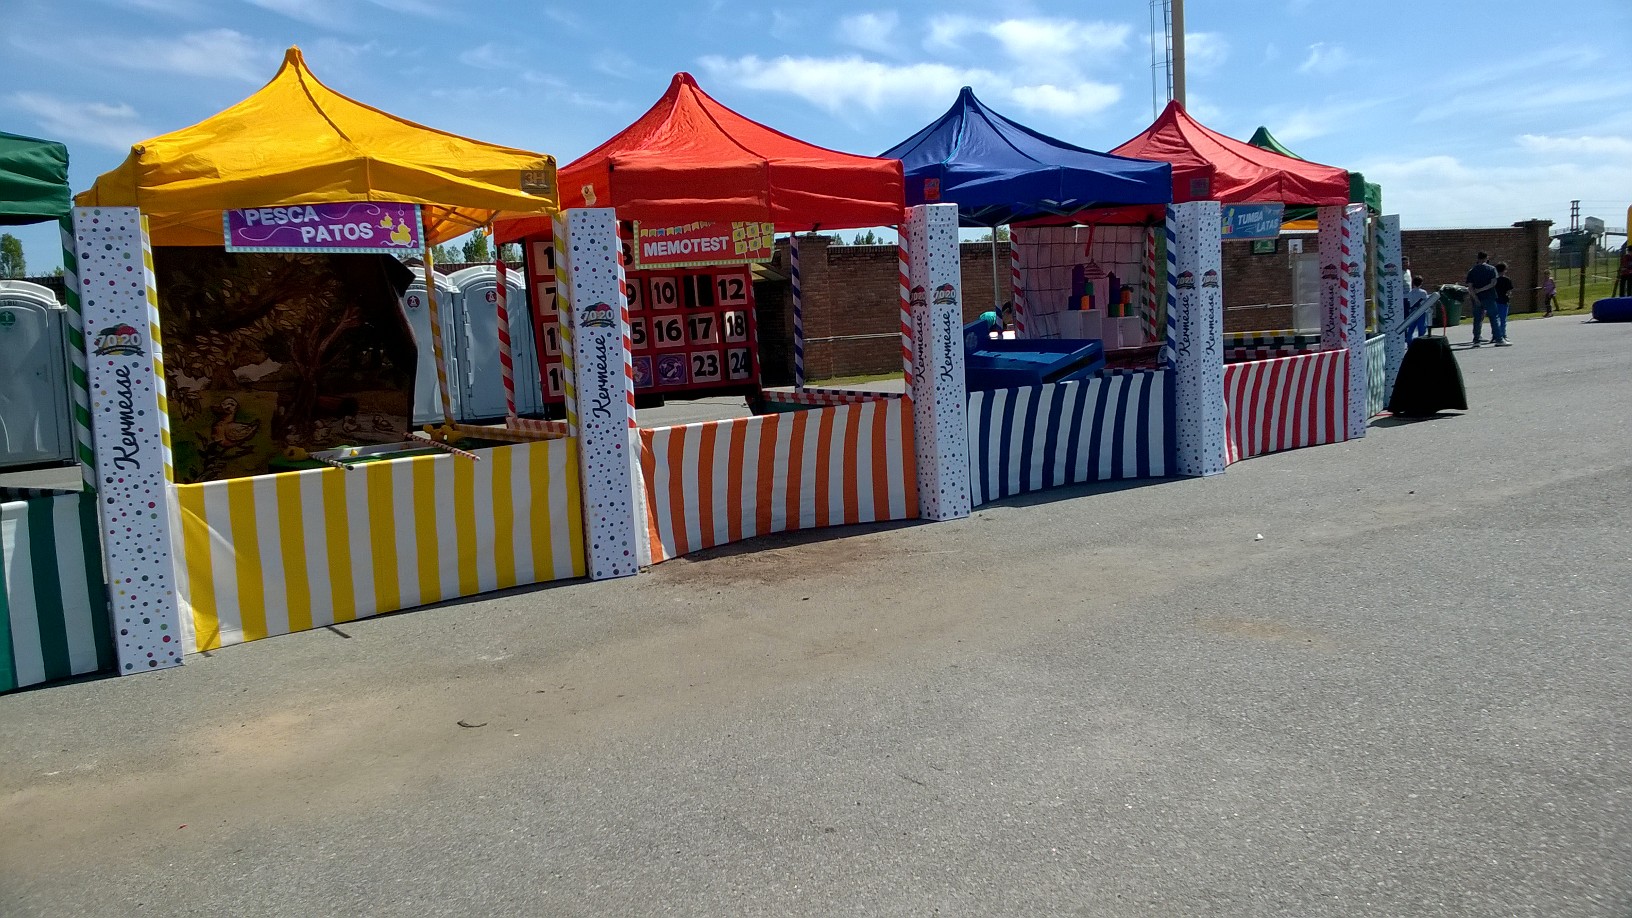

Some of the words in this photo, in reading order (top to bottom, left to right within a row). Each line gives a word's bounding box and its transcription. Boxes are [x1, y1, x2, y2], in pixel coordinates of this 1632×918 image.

[245, 205, 320, 227] PESCA
[300, 222, 374, 244] PATOS
[1237, 210, 1264, 226] TUMBA
[1256, 218, 1280, 233] LATAS
[643, 235, 730, 258] MEMOTEST
[653, 281, 675, 305] 10
[717, 278, 746, 301] 12
[547, 327, 562, 351] 1
[631, 321, 647, 345] 5
[654, 318, 682, 343] 16
[687, 316, 714, 341] 17
[726, 315, 745, 337] 18
[1178, 294, 1191, 357] Kermesse
[1205, 293, 1217, 356] Kermesse
[915, 312, 926, 384] Kermesse
[939, 311, 954, 382] Kermesse
[549, 367, 564, 391] 1
[692, 355, 719, 378] 23
[730, 351, 750, 374] 24
[591, 334, 612, 419] Kermesse
[112, 364, 141, 471] Kermesse
